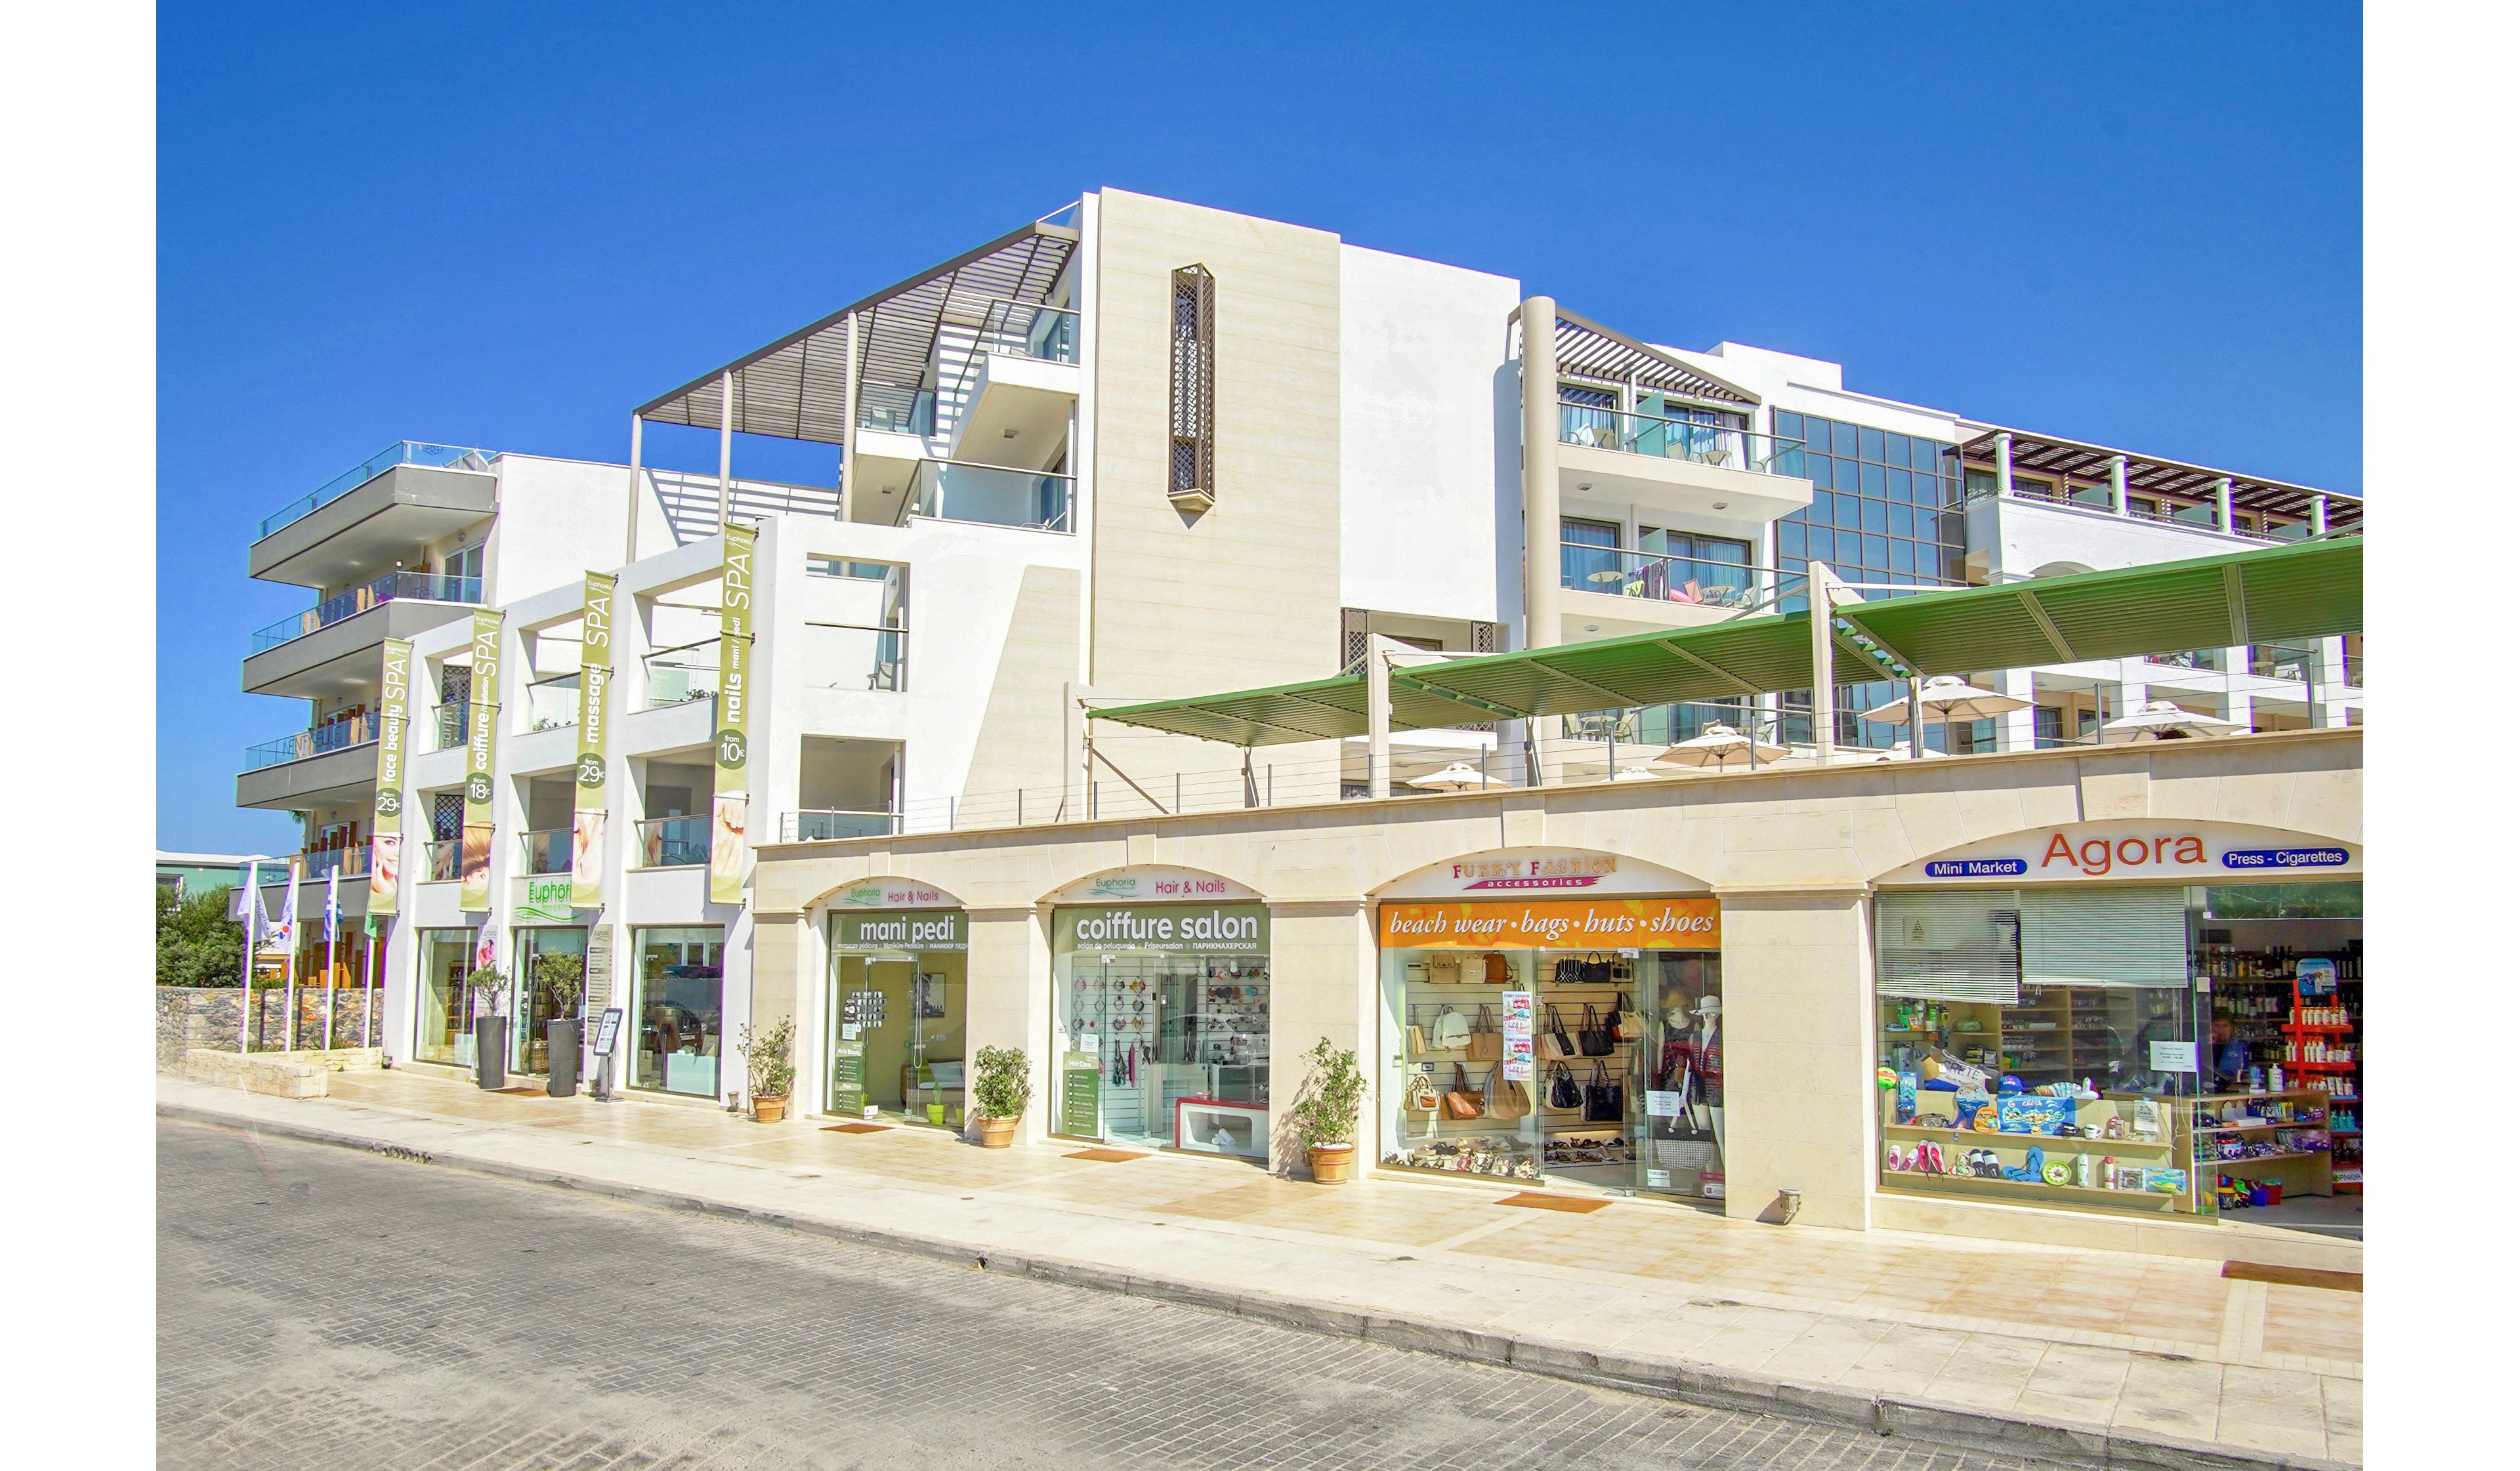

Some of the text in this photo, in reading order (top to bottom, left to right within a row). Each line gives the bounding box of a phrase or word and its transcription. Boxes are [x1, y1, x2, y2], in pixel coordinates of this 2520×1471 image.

[726, 533, 752, 545] Euphoria
[588, 580, 612, 590] Euphoria
[726, 554, 751, 610] SPA
[476, 615, 499, 624] Euphoria
[586, 597, 610, 648] SPA
[474, 631, 498, 676] SPA
[732, 645, 741, 669] mani
[385, 659, 407, 701] SPA
[587, 663, 605, 743] massage
[725, 673, 743, 723] nails
[383, 704, 404, 783] face beauty
[721, 742, 745, 762] 10€
[578, 764, 605, 781] 29€
[470, 783, 491, 799] 18€
[377, 797, 401, 812] 29€
[2041, 833, 2207, 876] Agora
[2229, 854, 2264, 865] Press
[2276, 852, 2342, 866] Cigarettes
[1452, 858, 1617, 879] FUNKY FASHION
[1935, 861, 2018, 875] Mini Market
[851, 888, 880, 898] Euphoria
[1096, 878, 1135, 887] Euphoria
[1156, 880, 1225, 894] Hair & Nails
[1487, 879, 1582, 887] accessories
[529, 881, 572, 907] Euphori
[888, 890, 939, 902] Hair & Nails
[860, 915, 955, 945] mani pedi
[1076, 909, 1257, 940] coiffure salon
[1390, 907, 1713, 941] beach wear bags huts shoes
[1942, 1060, 1981, 1081] CRETE
